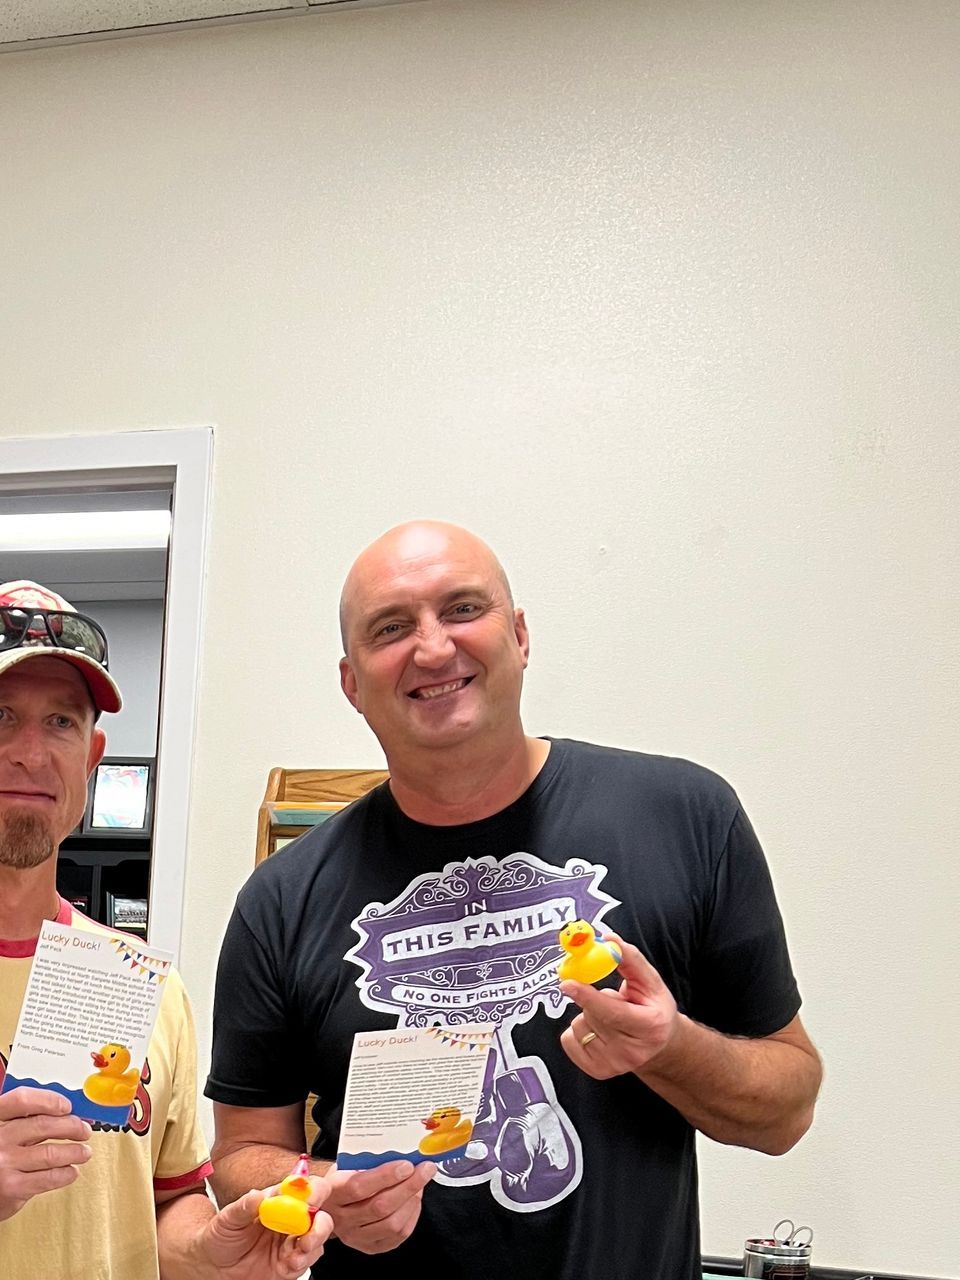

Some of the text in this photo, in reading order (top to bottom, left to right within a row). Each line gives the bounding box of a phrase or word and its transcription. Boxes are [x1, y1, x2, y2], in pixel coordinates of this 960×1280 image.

[464, 898, 487, 918] IN
[386, 904, 571, 955] THIS FAMILY
[41, 931, 101, 951] Lucky Duck!
[403, 965, 561, 1004] NO ONE FIGHTS ALON
[358, 1035, 418, 1048] Lucky Duck!
